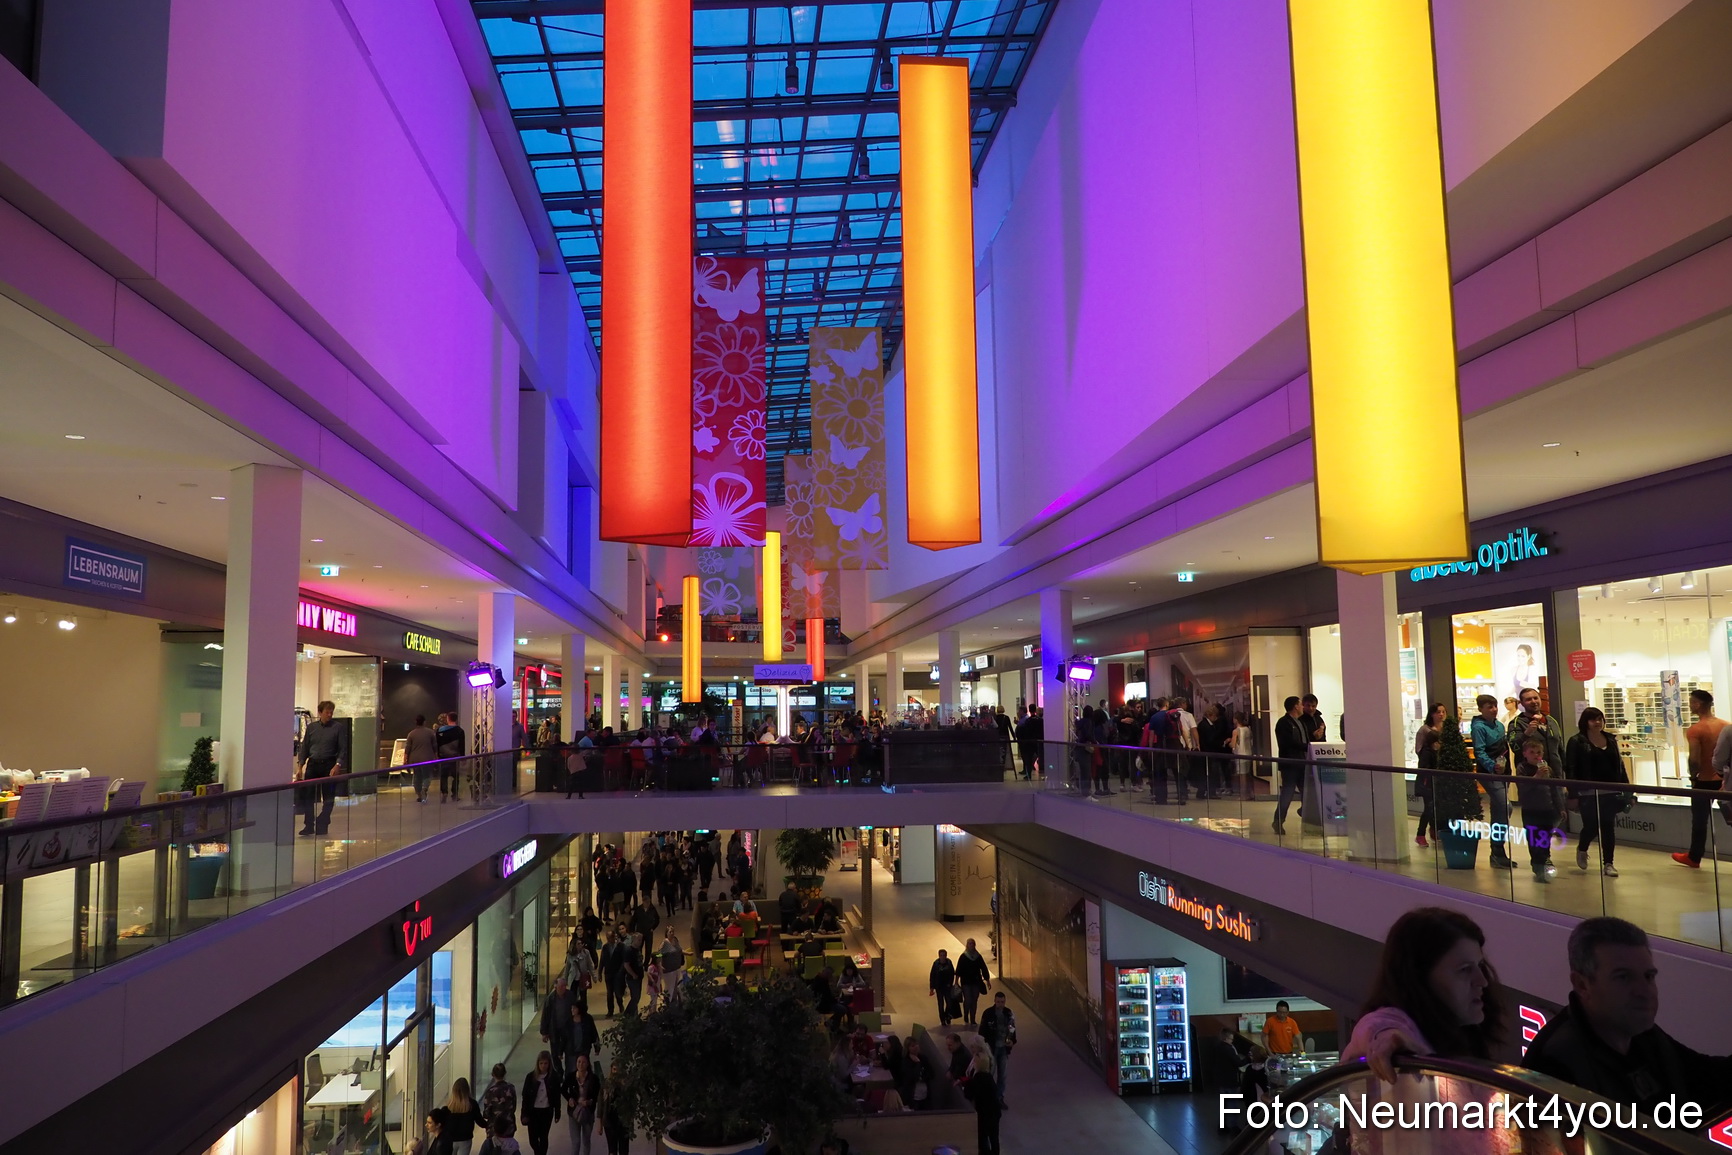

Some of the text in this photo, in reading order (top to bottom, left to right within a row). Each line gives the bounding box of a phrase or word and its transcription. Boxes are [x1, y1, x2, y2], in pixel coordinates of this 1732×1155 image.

[74, 555, 139, 583] LEBENSRAUM
[297, 601, 321, 629] LLY
[756, 668, 798, 678] Delizia
[1615, 814, 1656, 832] ktlinsen
[950, 864, 956, 872] IN
[1138, 871, 1252, 942] Oishii Running Sushi
[419, 915, 432, 941] TUI
